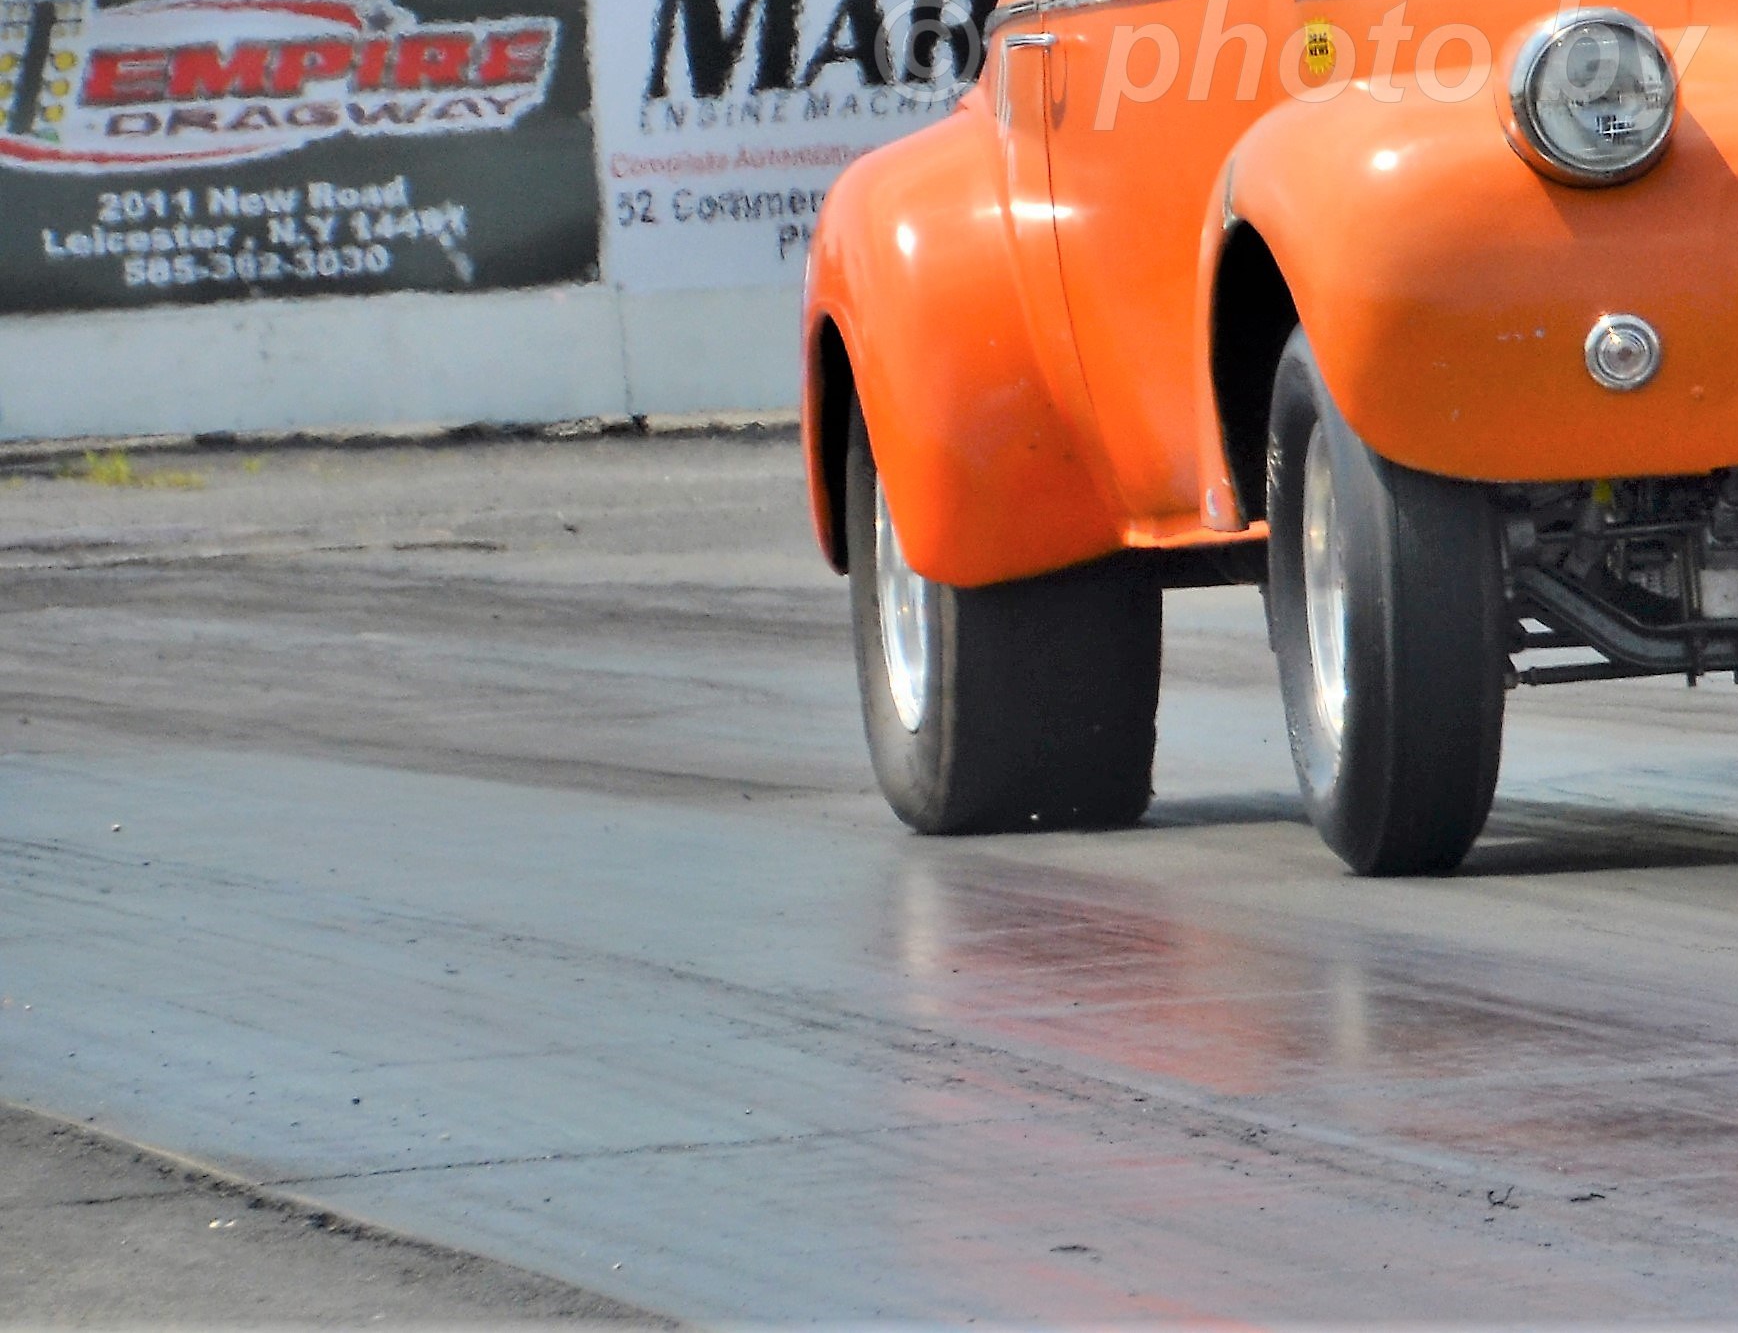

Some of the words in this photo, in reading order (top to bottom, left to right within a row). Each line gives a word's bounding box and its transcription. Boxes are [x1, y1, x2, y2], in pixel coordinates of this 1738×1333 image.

[78, 30, 550, 106] EMPIRE
[105, 91, 534, 138] DRAGWAY
[98, 187, 195, 223] 2011
[206, 185, 299, 216] New
[307, 174, 411, 211] Road
